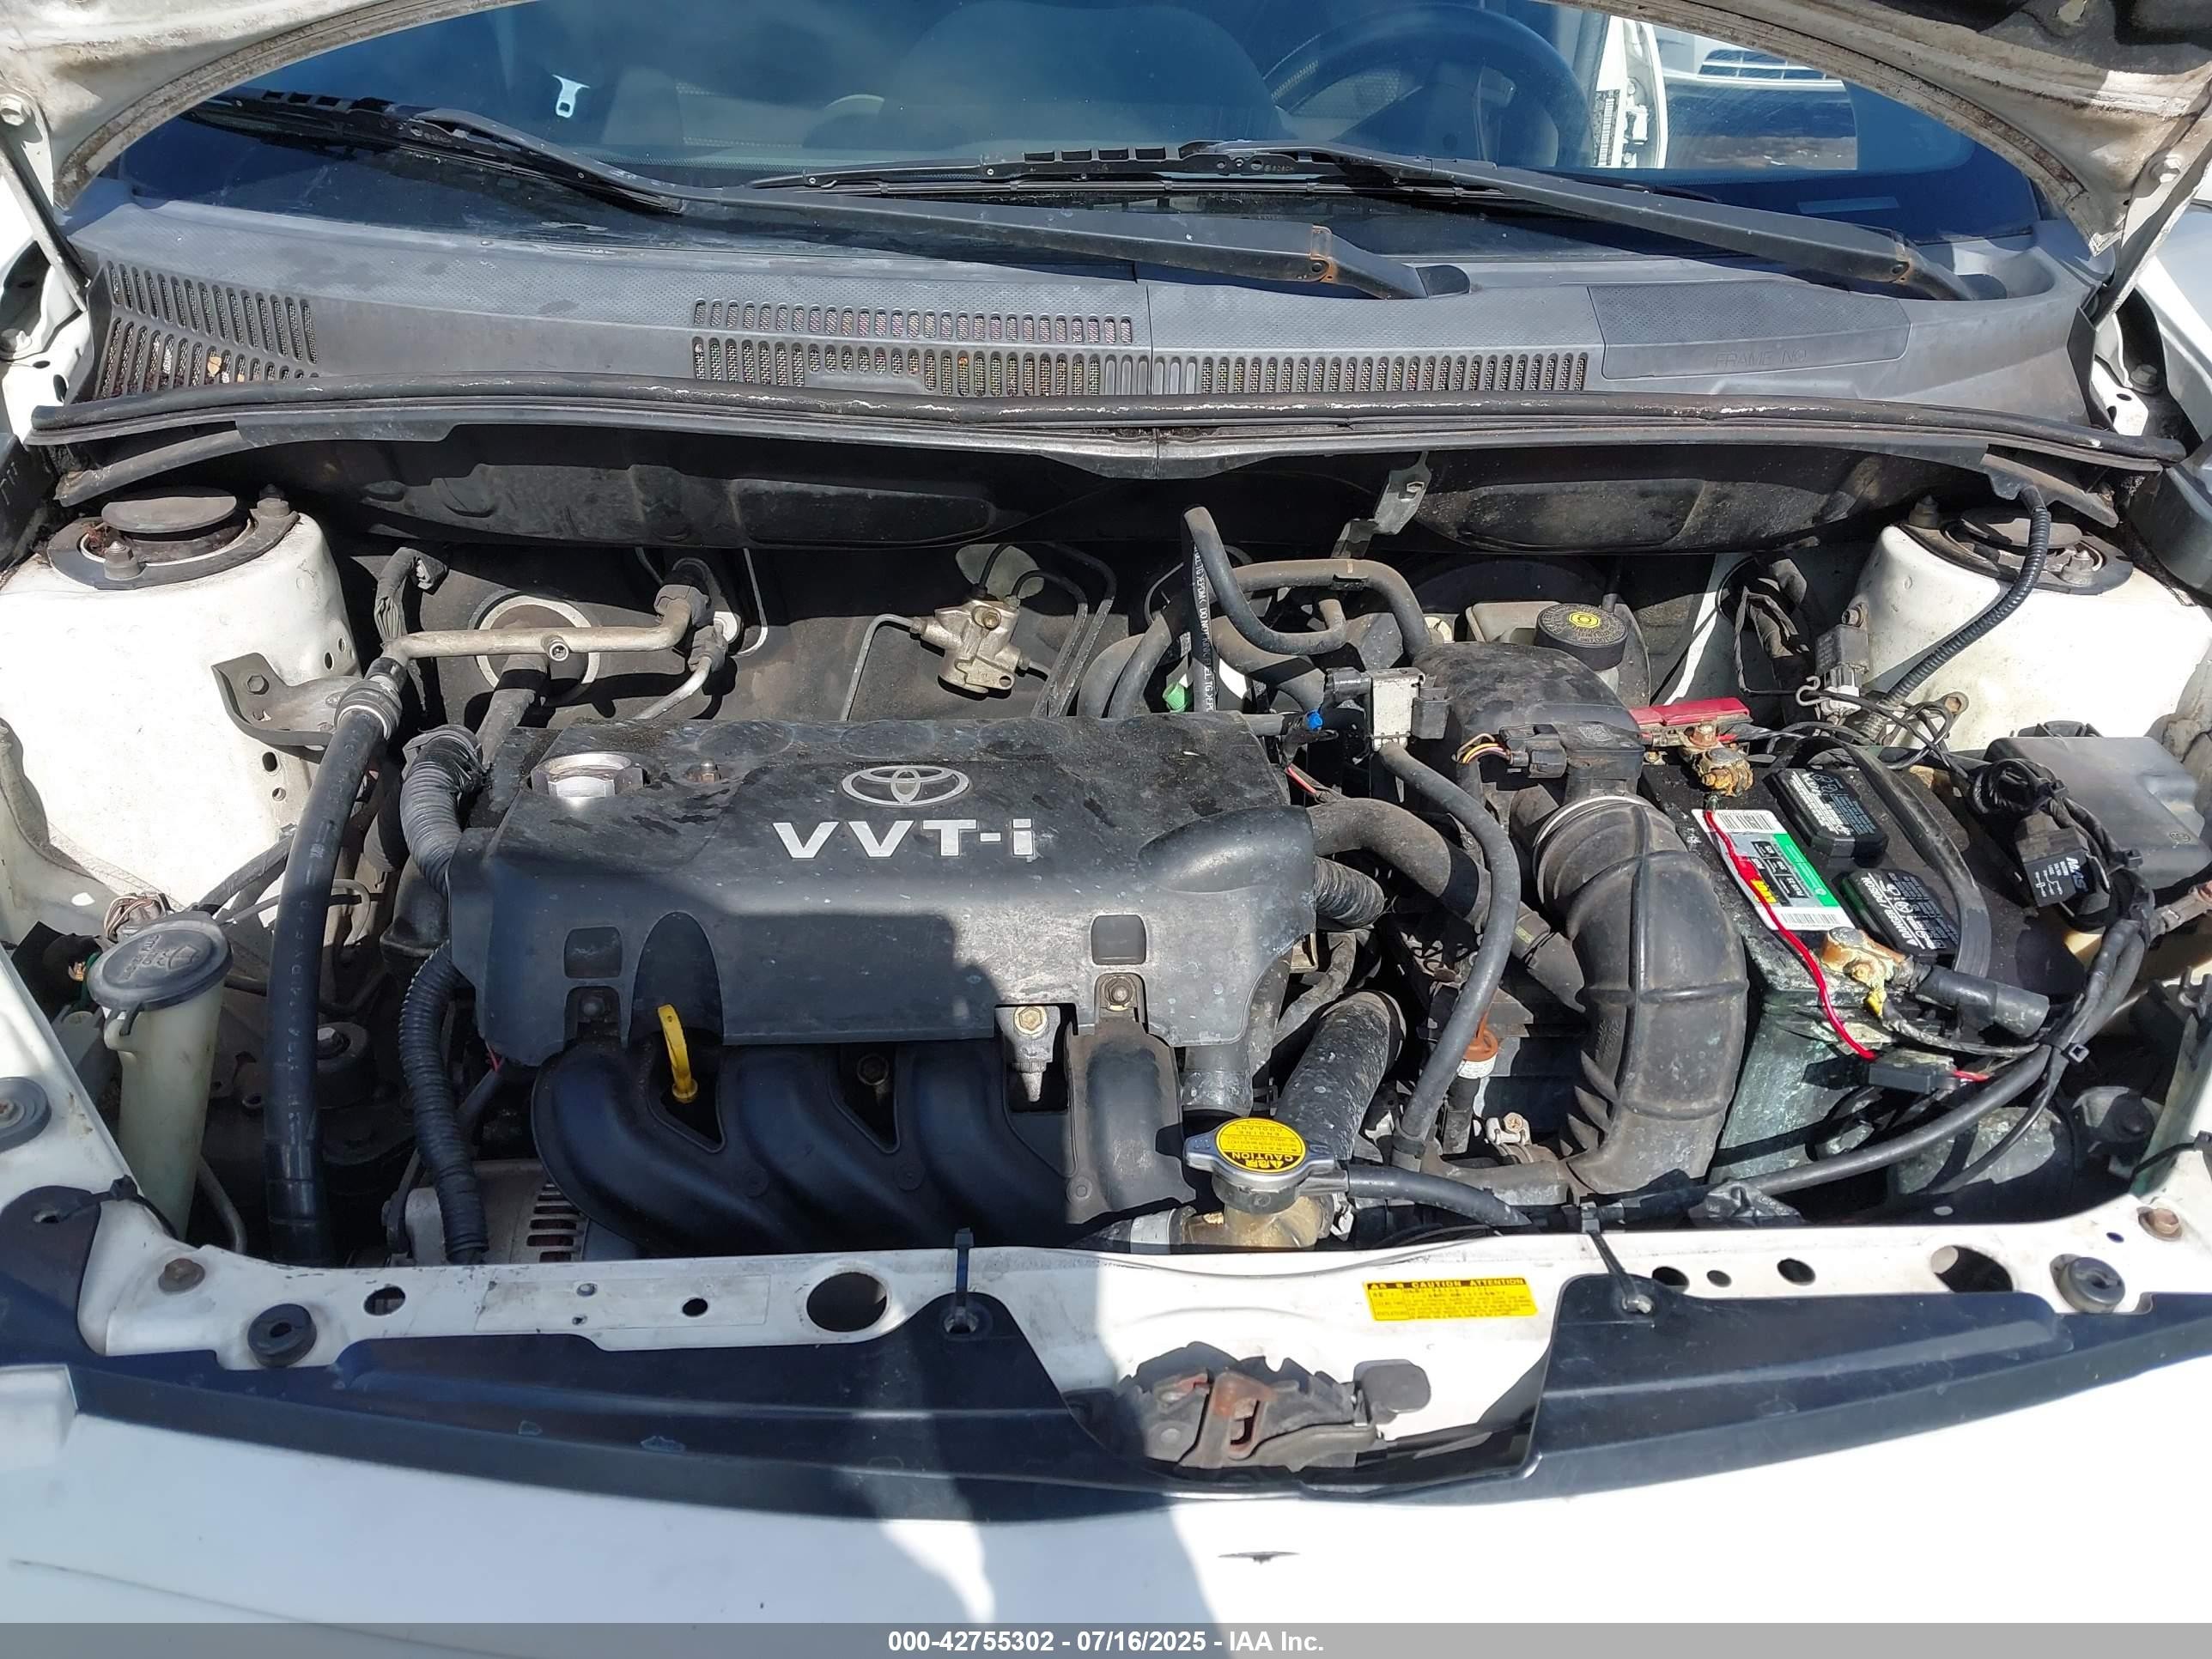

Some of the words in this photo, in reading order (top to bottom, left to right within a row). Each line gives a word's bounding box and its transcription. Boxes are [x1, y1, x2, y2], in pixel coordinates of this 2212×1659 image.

[1715, 351, 1773, 367] FRAME
[772, 818, 1034, 860] VVT-i
[1861, 877, 1887, 903] POISON
[1884, 909, 1913, 939] DANGER
[1231, 1152, 1294, 1161] CAUTION
[1411, 1280, 1462, 1289] CAUTION
[1469, 1278, 1524, 1287] ATTENTION
